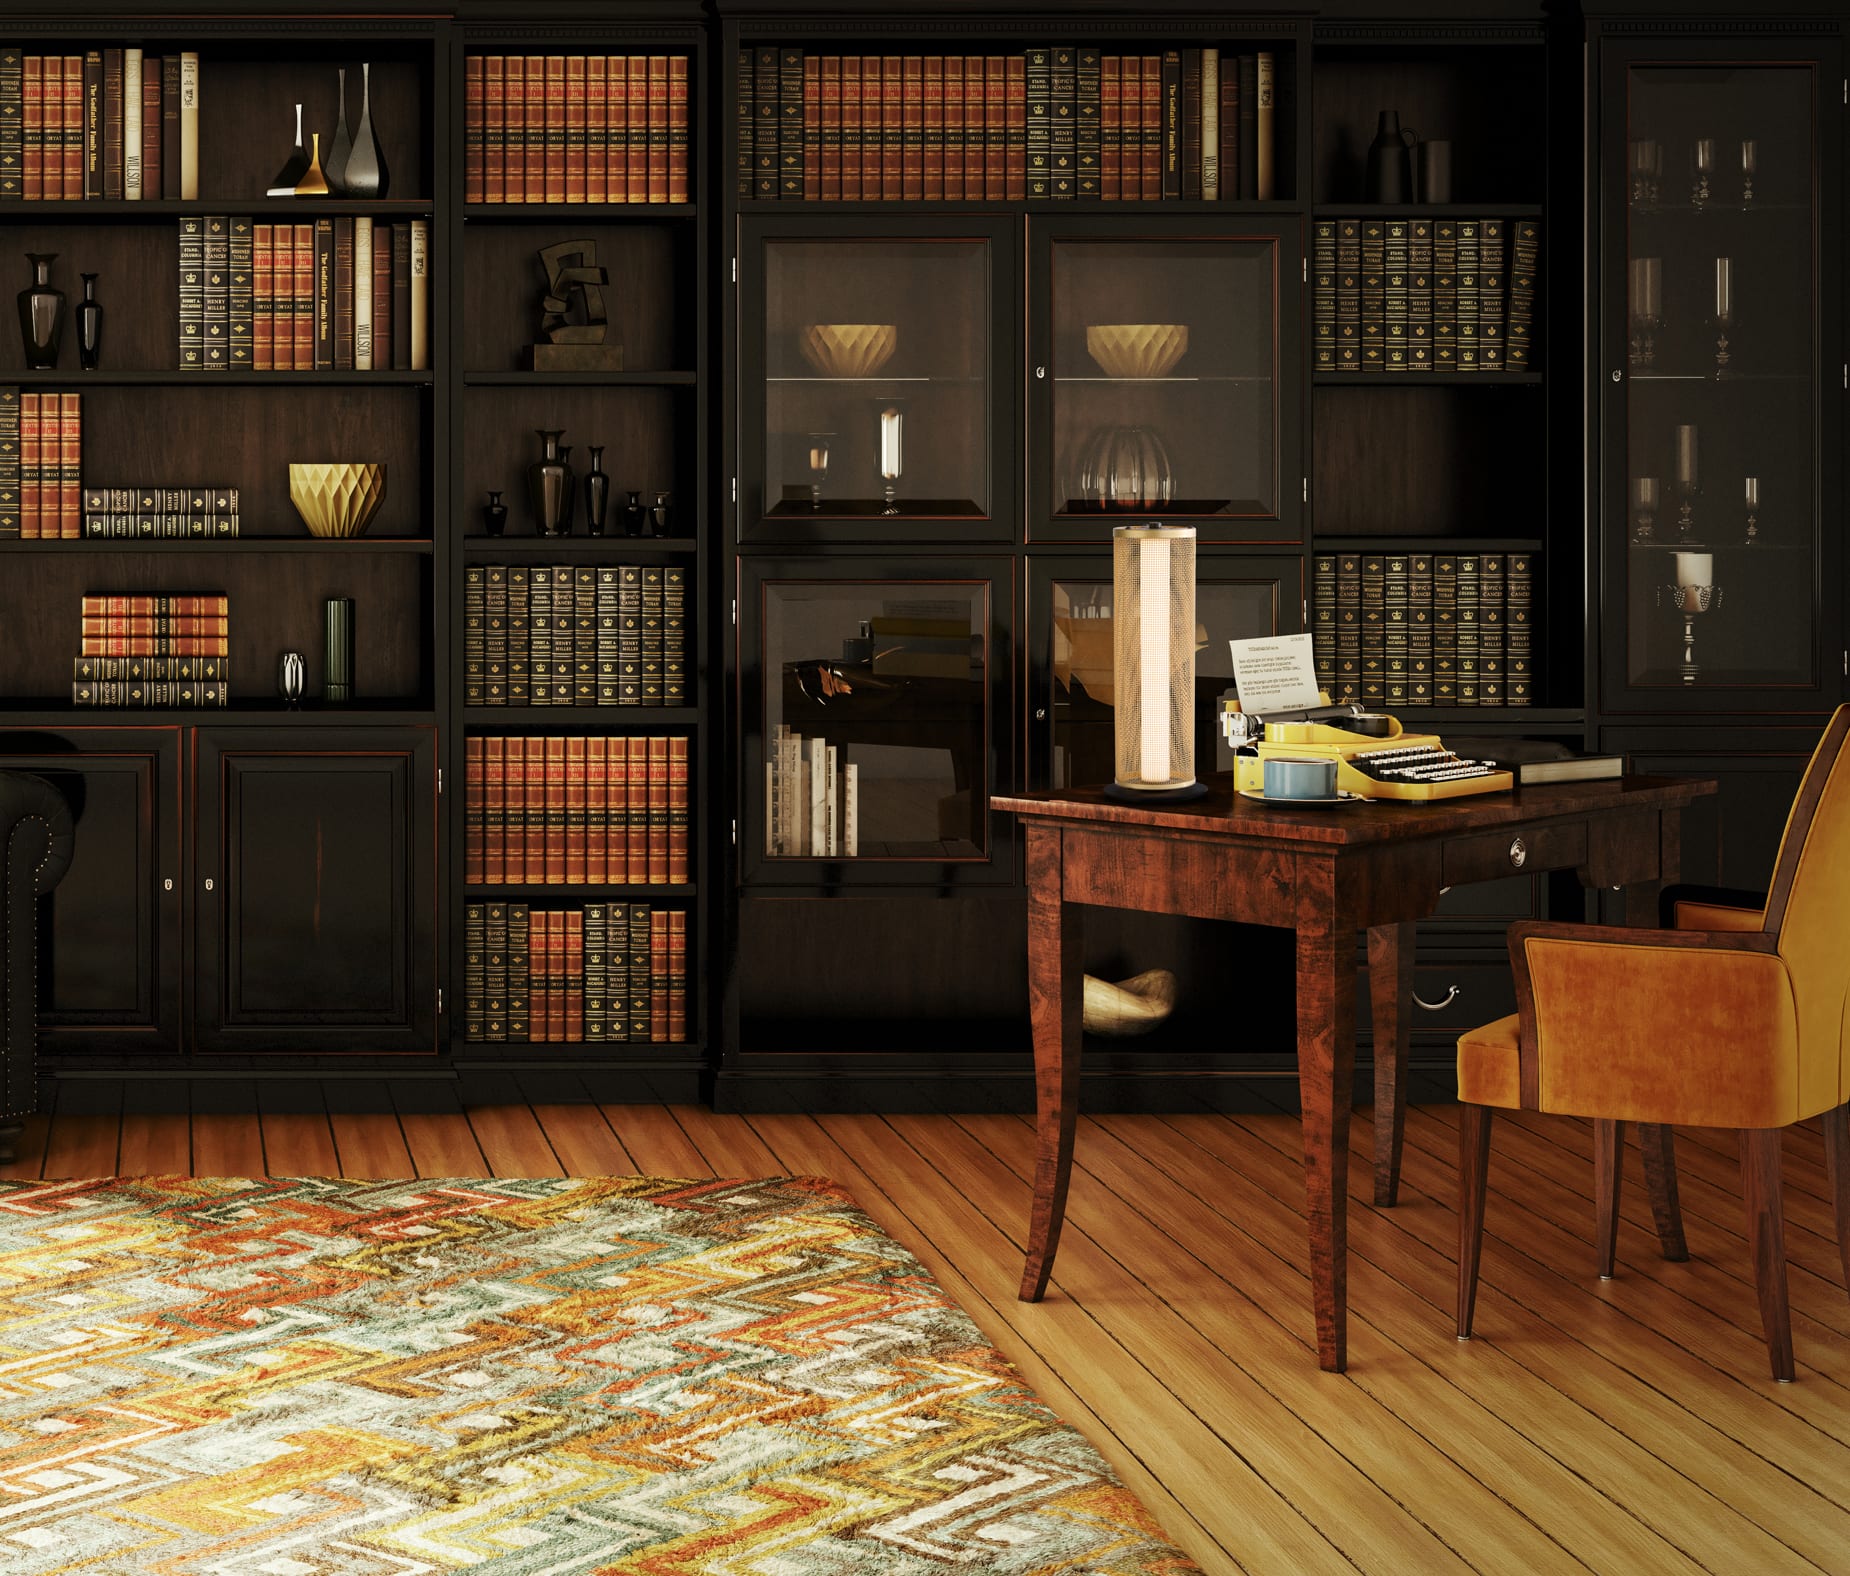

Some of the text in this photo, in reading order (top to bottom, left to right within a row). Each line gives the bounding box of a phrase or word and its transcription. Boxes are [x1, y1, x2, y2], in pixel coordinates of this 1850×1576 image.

[126, 155, 140, 188] WILLSON
[1204, 155, 1217, 189] WILLSON
[357, 324, 371, 357] WILLSON
